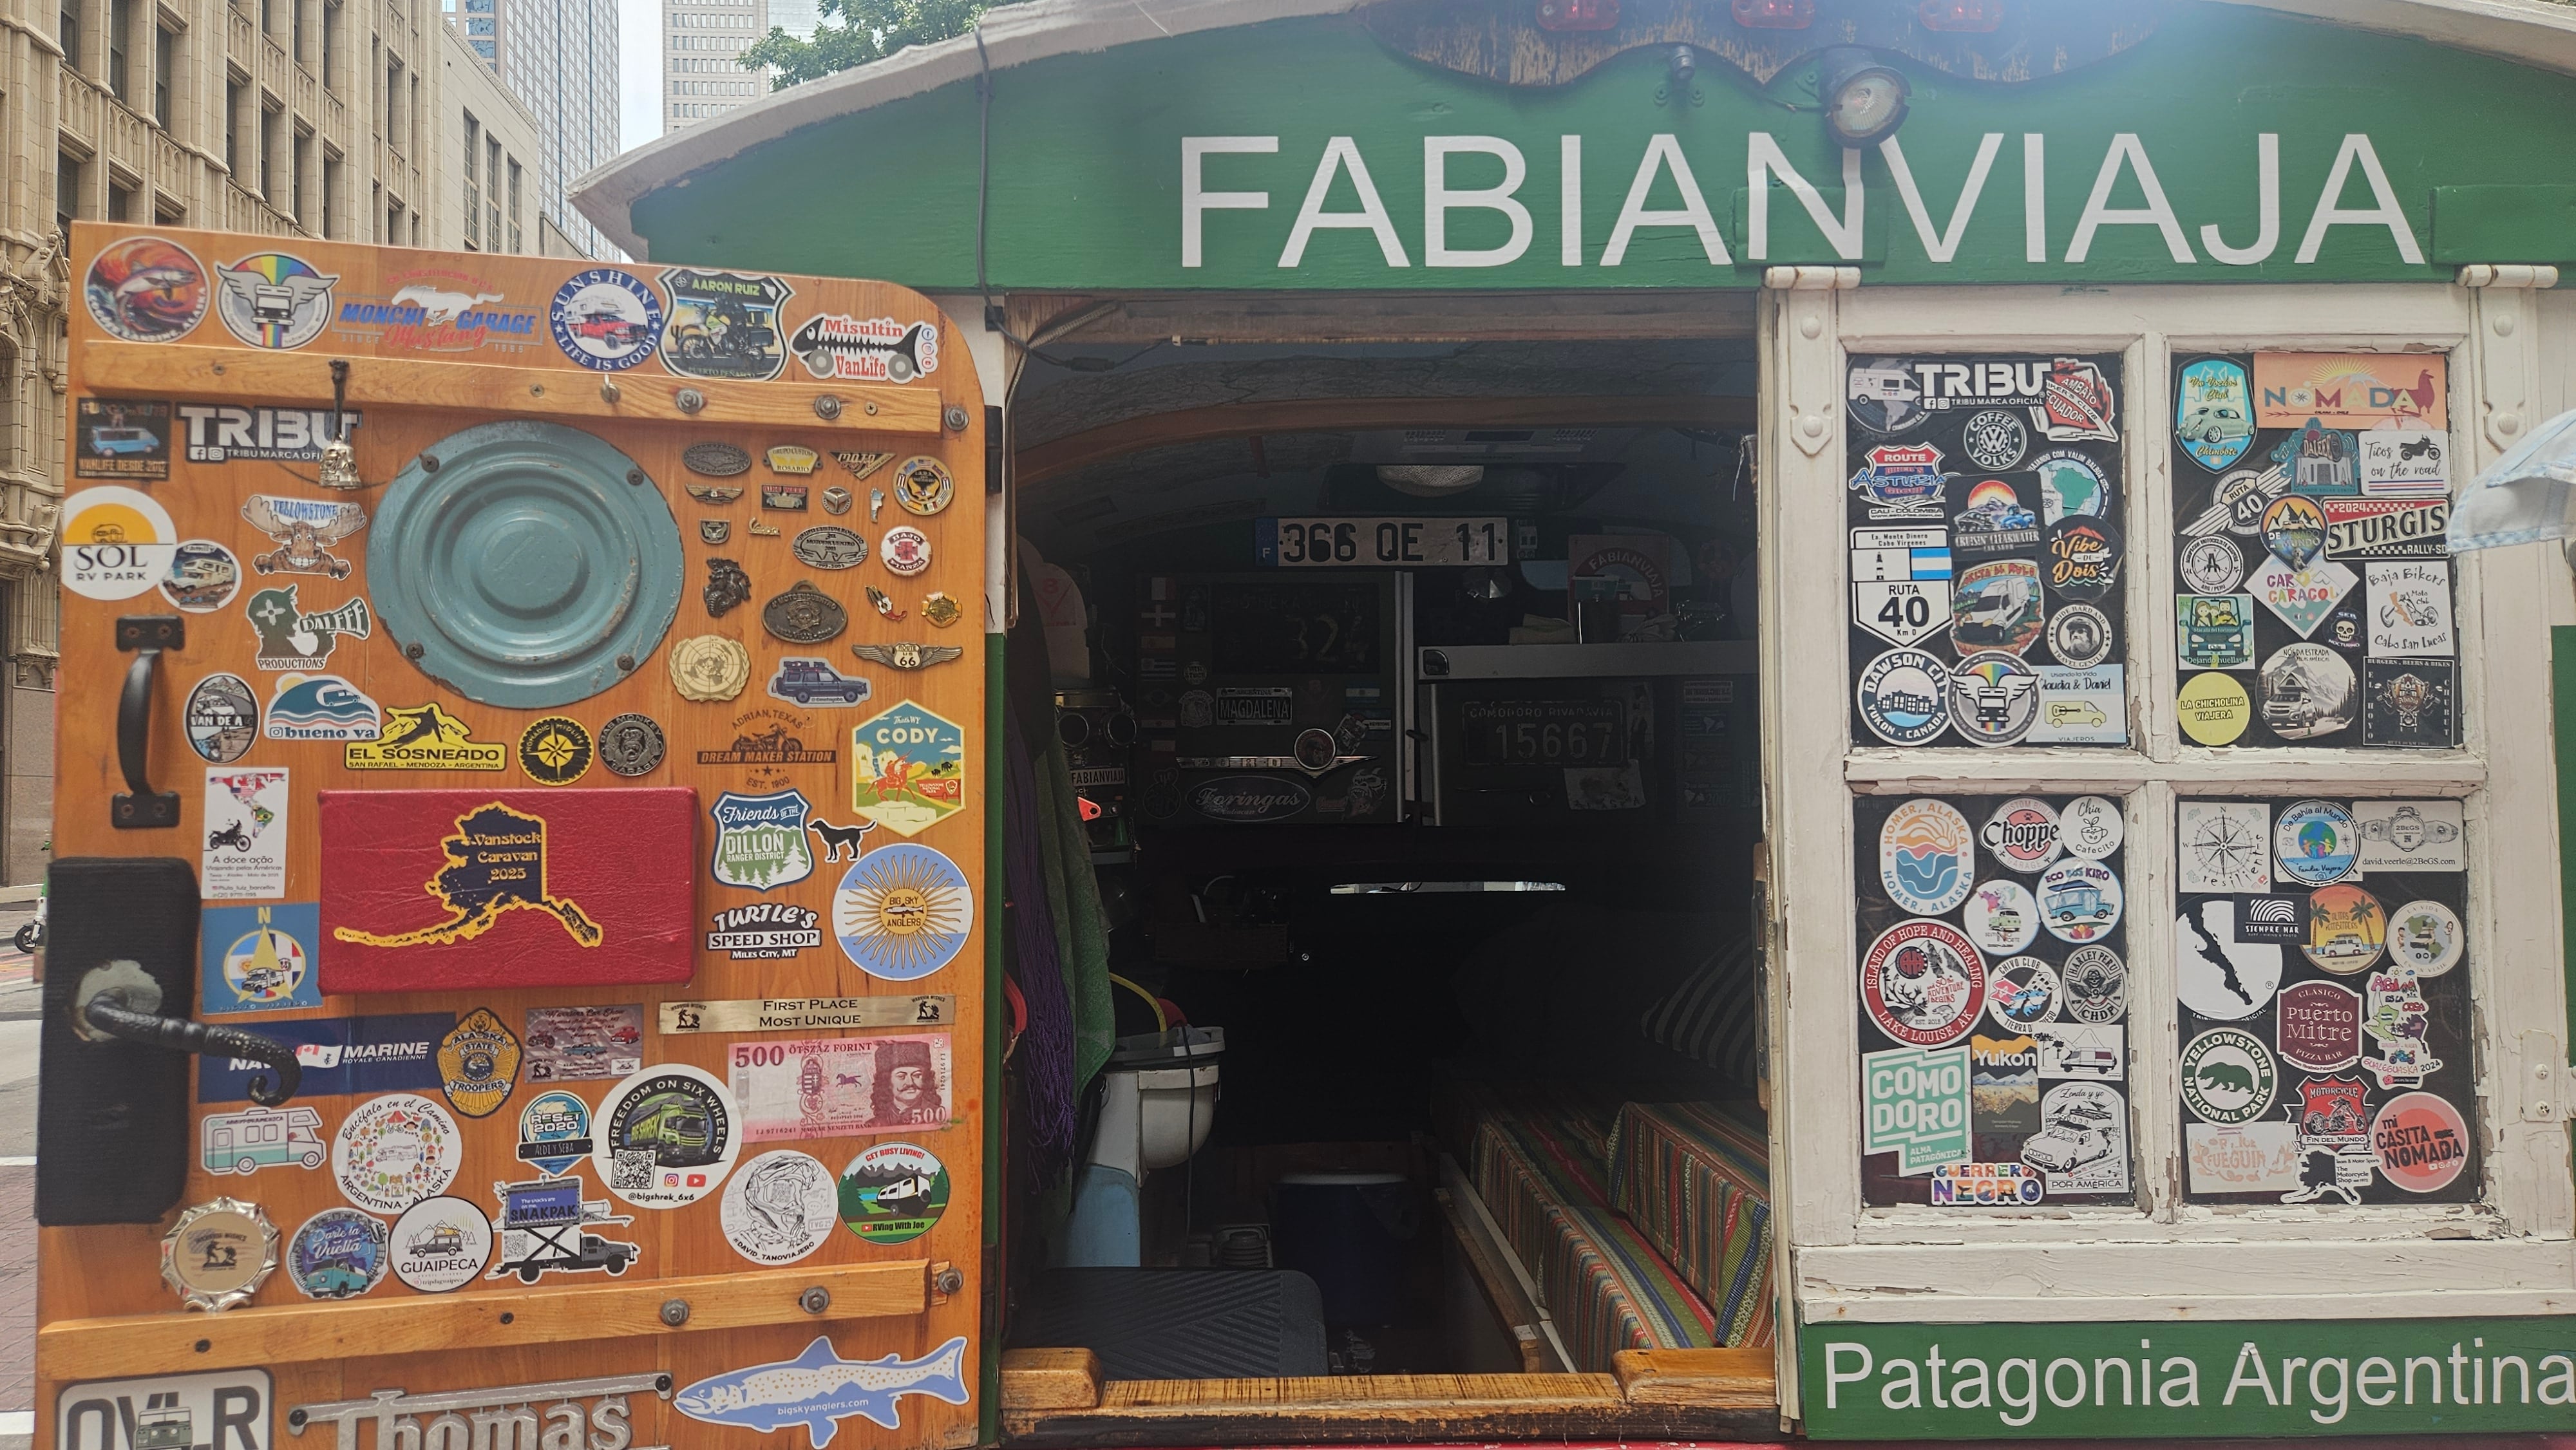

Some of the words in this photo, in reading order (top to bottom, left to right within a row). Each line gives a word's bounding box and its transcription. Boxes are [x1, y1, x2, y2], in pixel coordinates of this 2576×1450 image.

[1181, 133, 2425, 267] FABIANVIAJA
[551, 270, 662, 323] SUNSHINE
[692, 279, 733, 294] AARON
[735, 284, 760, 296] RUIZ
[824, 317, 904, 339] Misultin
[559, 338, 589, 366] LIFE
[595, 359, 612, 371] IS
[618, 334, 658, 370] GOOD
[835, 353, 886, 379] VanLife
[1916, 363, 2051, 397] TRIBU
[2265, 388, 2418, 408] NOMADA
[1970, 413, 2017, 431] COFFEE
[1884, 453, 1926, 462] ROUTE
[1973, 448, 2018, 466] VOLKS
[2365, 442, 2392, 460] Ticos
[2371, 467, 2385, 476] on
[2391, 464, 2409, 478] the
[2414, 460, 2441, 476] road
[273, 500, 338, 521] YELLOWSTONE
[2327, 505, 2445, 549] STURGIS
[1283, 523, 1356, 562] 366
[1377, 523, 1423, 561] QE
[1456, 523, 1495, 561] 11
[2052, 535, 2103, 558] Vibe
[74, 546, 149, 570] SOL
[77, 572, 97, 581] RV
[104, 572, 146, 581] PARK
[2052, 561, 2100, 583] Dois
[1889, 585, 1920, 596] RUTA
[1878, 596, 1929, 627] 40
[2374, 634, 2400, 649] Cabo
[2421, 632, 2447, 648] Lucas
[258, 658, 325, 670] PRODUCTIONS
[900, 657, 915, 666] 66
[1864, 654, 1926, 693] DAWSON
[1220, 699, 1289, 717] MAGDALENA
[2181, 701, 2193, 710] LA
[2195, 698, 2244, 708] CHICHOLINA
[732, 710, 772, 731] ADRIAN,
[773, 710, 802, 729] TEXAS
[1868, 704, 1895, 736] YUKON
[1906, 711, 1947, 739] CANADA
[2195, 712, 2233, 720] VIAJERA
[284, 726, 348, 739] bueno
[354, 728, 375, 739] va
[876, 728, 938, 744] CODY
[348, 748, 375, 759] EL
[381, 746, 498, 761] SOSNEADO
[701, 752, 741, 762] DREAM
[744, 752, 783, 762] MAKER
[787, 751, 832, 762] STATION
[1072, 770, 1124, 784] FABIANVIAJA
[723, 805, 780, 824] Friends
[2284, 821, 2293, 832] De
[2291, 807, 2313, 822] Bahía
[2324, 807, 2347, 828] Mundo
[1884, 803, 1923, 844] HOMER,
[1927, 803, 1968, 845] ALASKA
[472, 833, 541, 846] Vanstock
[725, 833, 783, 854] DILLON
[478, 851, 538, 863] Caravan
[726, 853, 753, 862] RANGER
[755, 852, 784, 861] DISTRICT
[2362, 858, 2456, 867] david.veerle@2BeGS.com
[491, 869, 527, 881] 2025
[889, 896, 900, 905] BIG
[1884, 871, 1923, 912] HOMER,
[1931, 871, 1971, 912] ALASKA
[887, 918, 922, 928] ANGLERS
[712, 934, 766, 947] SPEED
[770, 932, 817, 945] SHOP
[1866, 948, 1886, 990] ISLAND
[1883, 936, 1897, 948] OF
[1899, 926, 1927, 941] HOPE
[1931, 928, 1953, 943] AND
[1954, 936, 1982, 989] HEALING
[2287, 1007, 2352, 1023] Puerto
[1878, 1012, 1908, 1039] LAKE
[1911, 1026, 1959, 1042] LOUISE,
[1958, 1010, 1975, 1026] AK
[2287, 1022, 2351, 1041] Mitre
[343, 1042, 429, 1058] MARINE
[465, 1043, 492, 1052] STATE
[833, 1042, 872, 1051] FORINT
[2184, 1033, 2271, 1077] YELLOWSTONE
[735, 1046, 784, 1068] 500
[1975, 1049, 2036, 1067] Yukon
[451, 1080, 505, 1092] TROOPERS
[1872, 1066, 1962, 1100] COMO
[2184, 1077, 2240, 1121] NATIONAL
[2242, 1086, 2269, 1117] PARK
[2310, 1087, 2358, 1098] MOTORCYCLE
[531, 1113, 582, 1124] RESET
[611, 1084, 652, 1147] FREEDOM
[657, 1080, 677, 1089] ON
[682, 1082, 705, 1096] SIX
[707, 1097, 724, 1154] WHEELS
[911, 1107, 945, 1124] 500
[1874, 1099, 1962, 1134] DORO
[534, 1123, 577, 1133] 2020
[2377, 1126, 2429, 1149] CASITA
[866, 1151, 878, 1162] GET
[900, 1147, 925, 1159] LIVING!
[2384, 1139, 2465, 1169] NOMADA
[1936, 1165, 2036, 1178] GUERRERO
[1933, 1180, 2041, 1203] NEGRO
[2076, 1178, 2122, 1188] AMÉRICA
[628, 1193, 694, 1201] @bigshrek_6x6
[873, 1222, 893, 1232] RVing
[895, 1221, 911, 1230] With
[401, 1260, 478, 1274] GUAIPECA
[1824, 1339, 2199, 1427] Patagonia
[2223, 1338, 2576, 1424] Argentina
[777, 1397, 869, 1417] bigskyanglers.com
